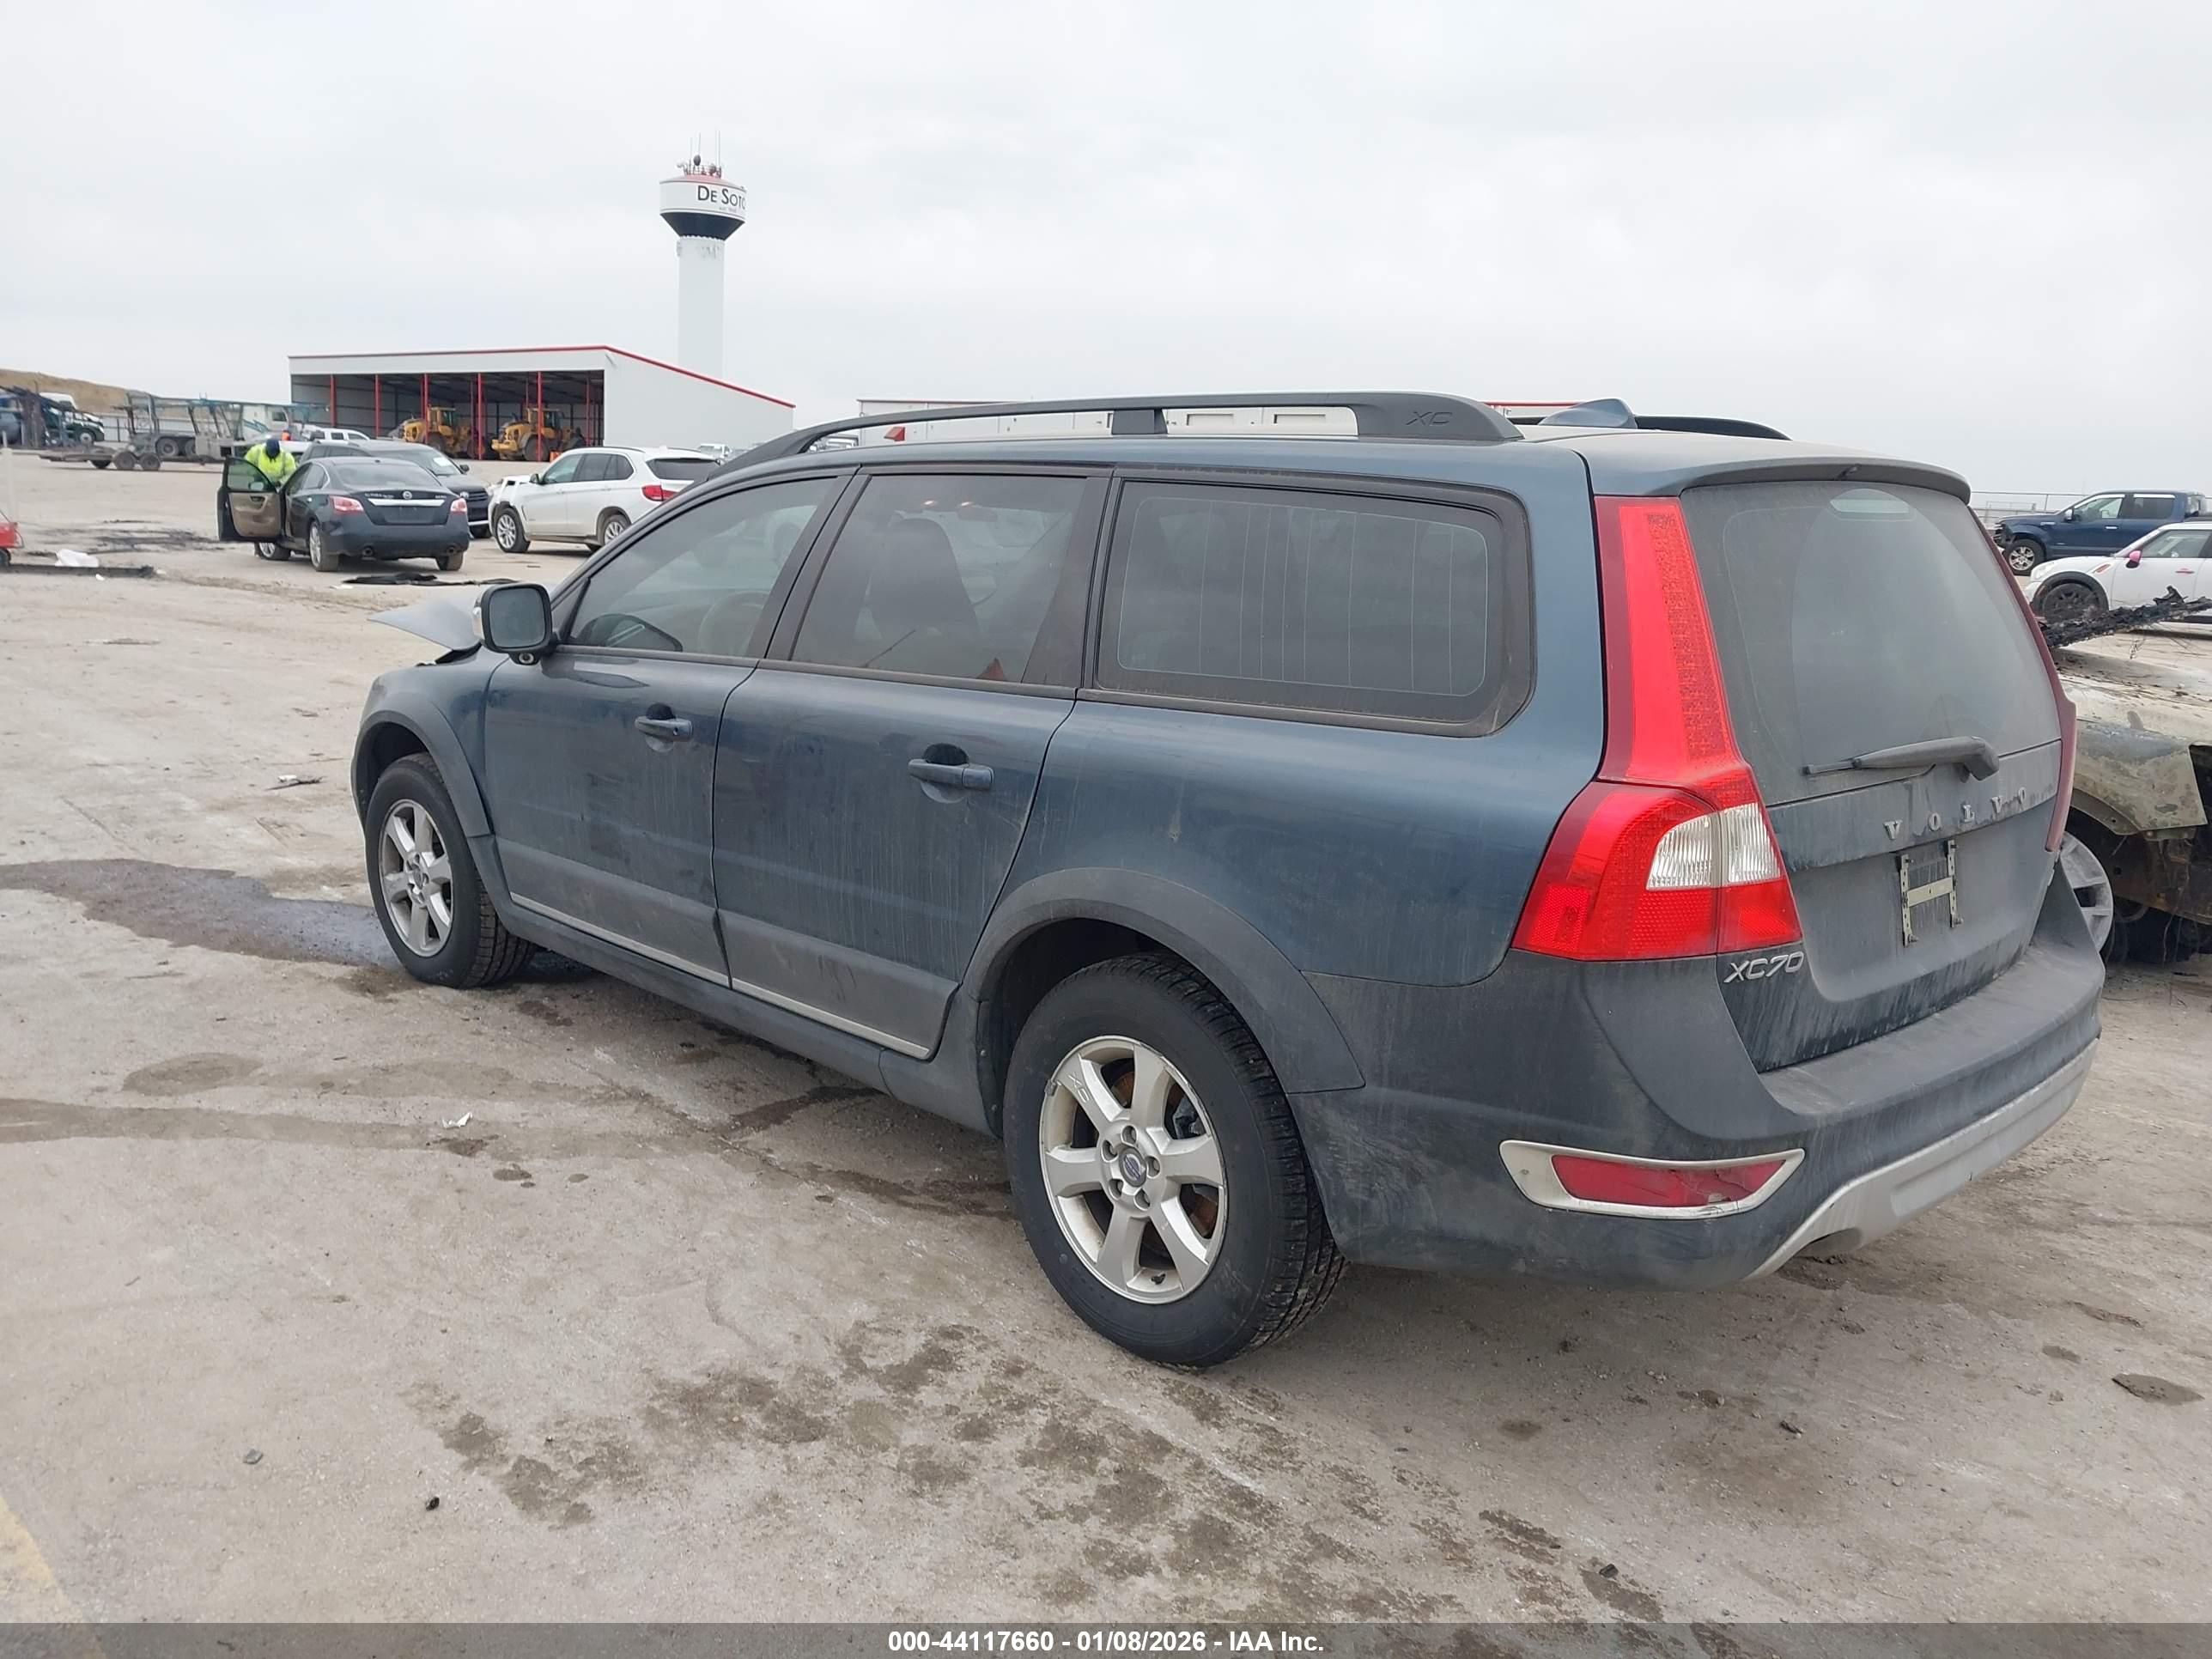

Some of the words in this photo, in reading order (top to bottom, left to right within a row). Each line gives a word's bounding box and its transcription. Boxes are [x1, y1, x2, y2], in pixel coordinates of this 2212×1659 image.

[1405, 410, 1453, 426] XC
[1883, 787, 2027, 840] VOLVO
[1723, 951, 1804, 983] XC70
